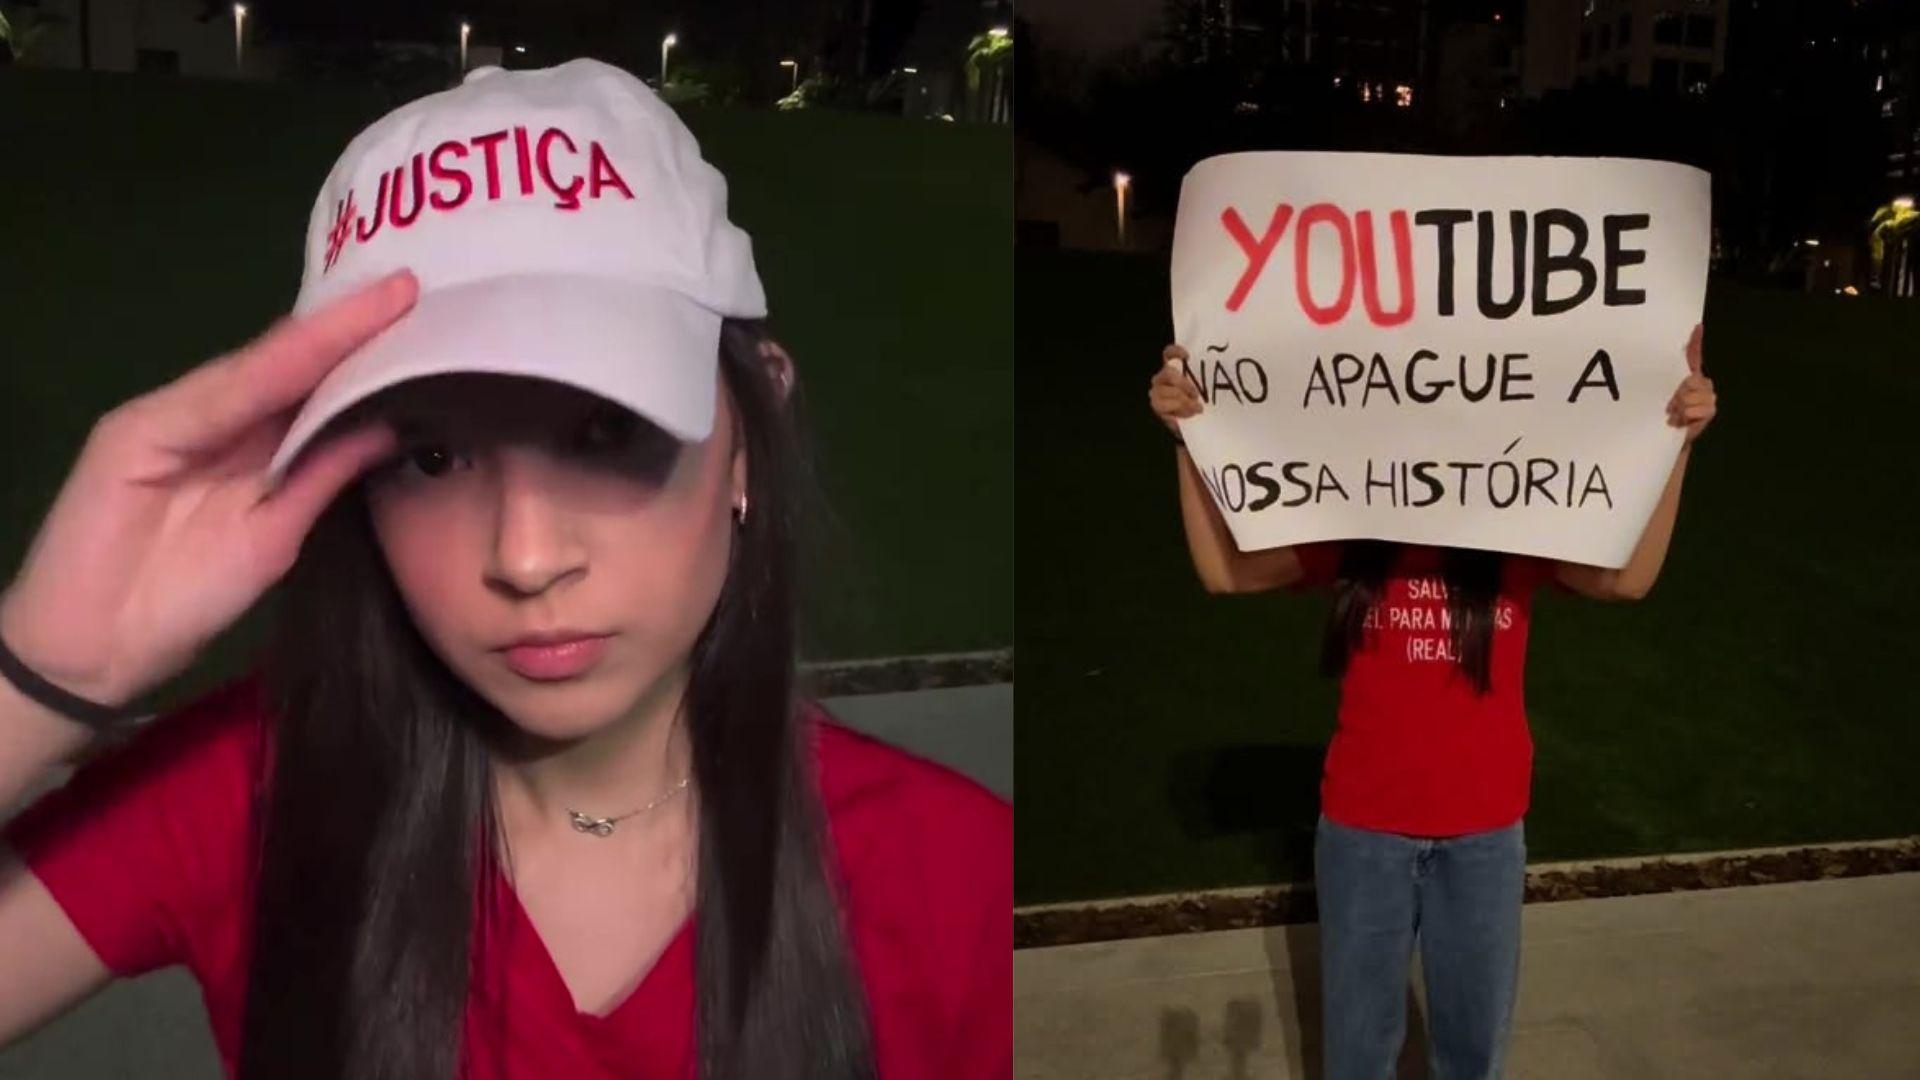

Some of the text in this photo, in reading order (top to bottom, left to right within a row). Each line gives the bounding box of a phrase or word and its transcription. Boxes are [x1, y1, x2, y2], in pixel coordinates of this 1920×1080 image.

[323, 126, 635, 274] #JUSTIÇA
[1220, 202, 1650, 327] YOUTUBE
[1183, 342, 1620, 409] NÃO APAGUE A
[1365, 436, 1613, 510] HISTÓRIA
[1389, 606, 1436, 630] PARA
